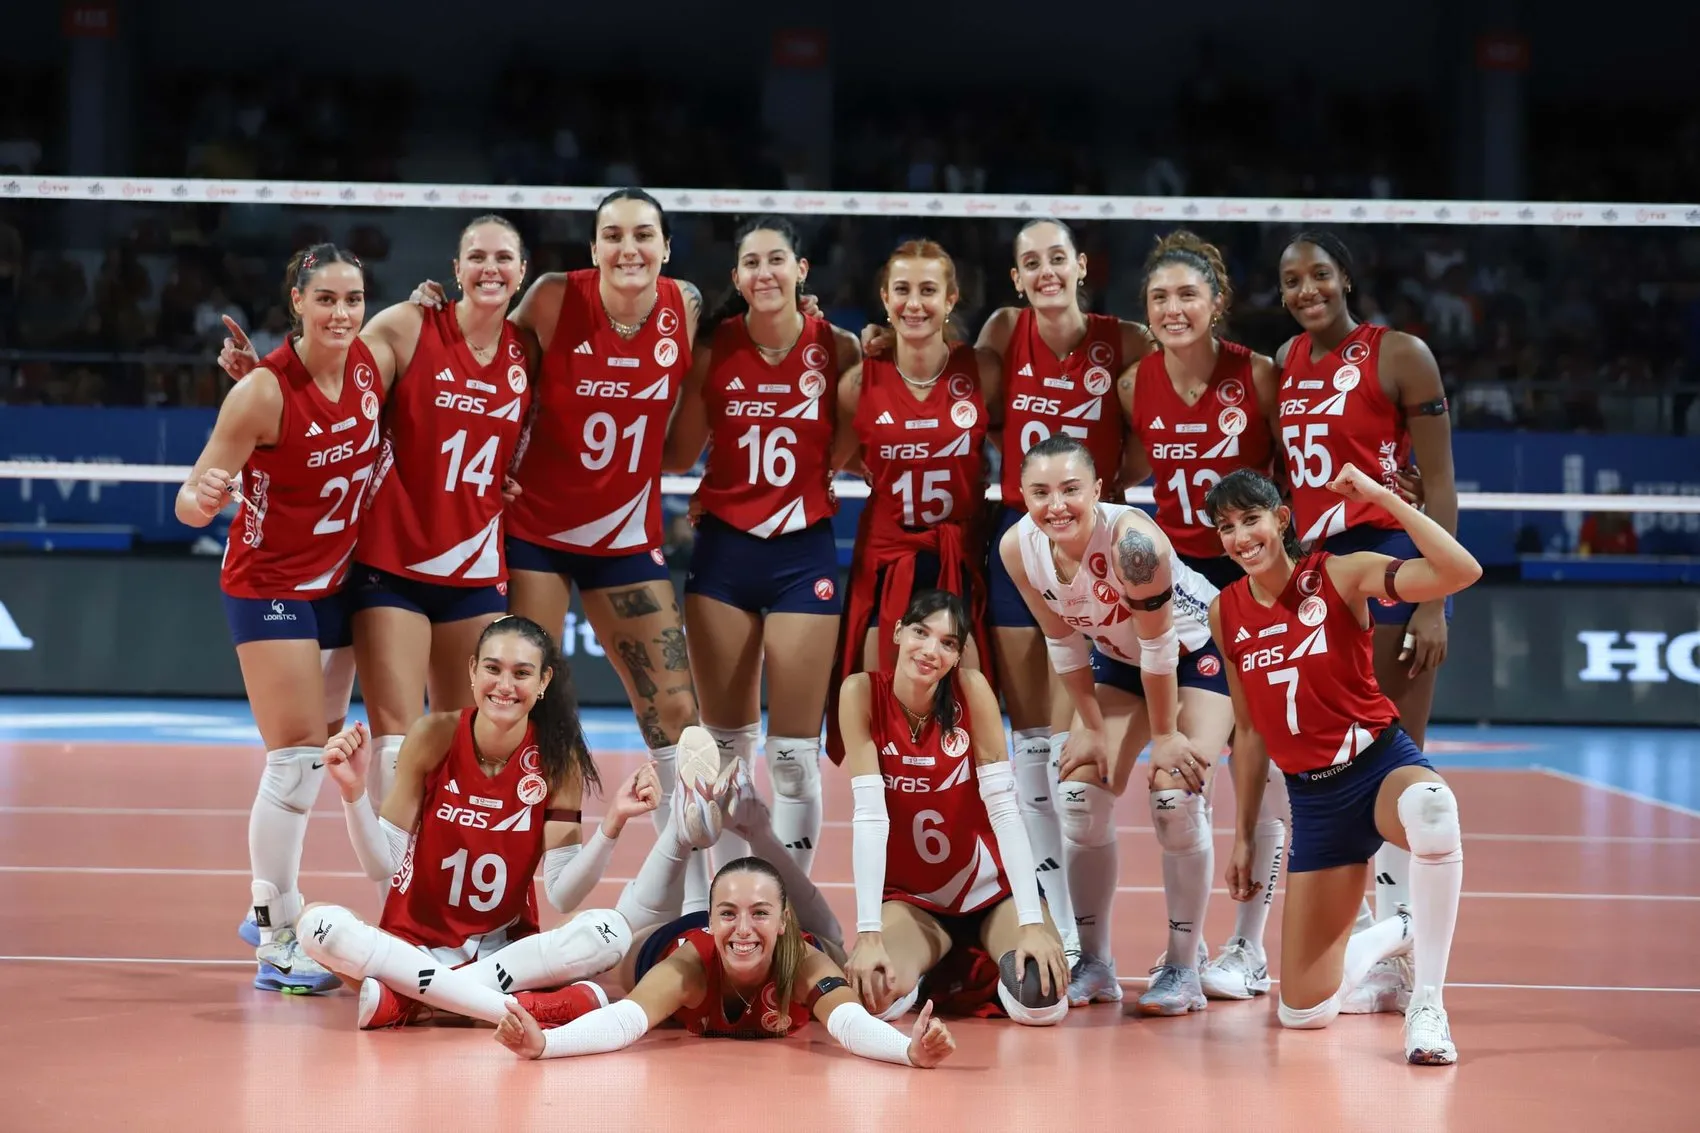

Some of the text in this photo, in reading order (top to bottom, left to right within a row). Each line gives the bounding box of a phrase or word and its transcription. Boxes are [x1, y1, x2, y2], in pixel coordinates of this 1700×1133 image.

[576, 379, 630, 398] aras
[435, 391, 487, 414] aras
[726, 400, 777, 417] aras
[1012, 394, 1061, 415] aras
[307, 440, 354, 468] aras
[580, 411, 648, 473] 91
[880, 442, 930, 459] aras
[1153, 443, 1198, 459] aras
[440, 429, 500, 497] 14
[738, 425, 798, 487] 16
[1282, 423, 1333, 489] 55
[313, 463, 374, 535] 27
[892, 469, 954, 526] 15
[263, 613, 297, 621] LOGISTICS
[1242, 645, 1284, 672] aras
[1266, 666, 1301, 735] 7
[885, 774, 931, 793] aras
[437, 802, 491, 829] aras
[912, 809, 951, 864] 6
[441, 847, 508, 912] 19
